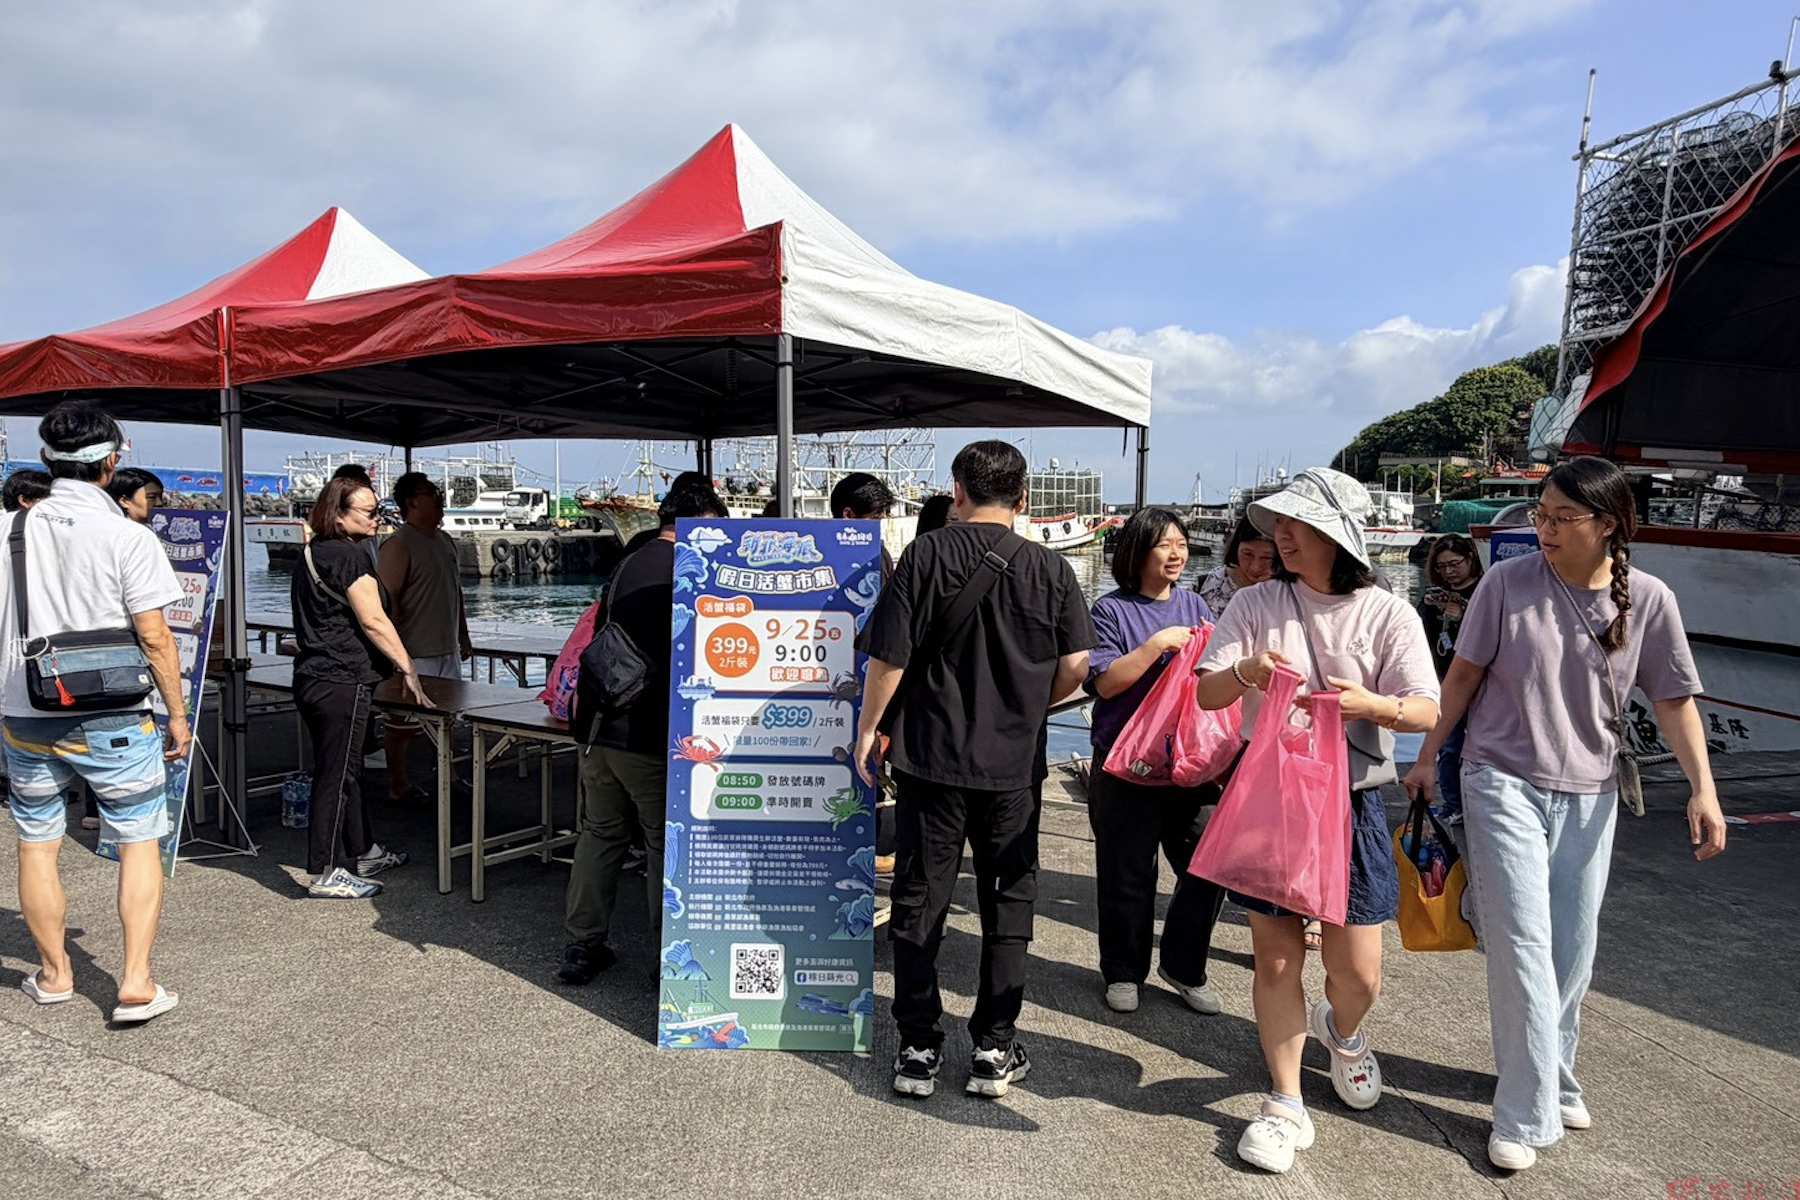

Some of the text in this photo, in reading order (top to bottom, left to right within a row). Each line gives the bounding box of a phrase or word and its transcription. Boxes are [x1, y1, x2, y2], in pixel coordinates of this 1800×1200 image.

[718, 567, 834, 591] 假日活蟹市集
[703, 602, 747, 613] 活蟹福袋
[775, 644, 827, 662] 9:00
[719, 657, 749, 669] 2斤裝
[701, 715, 760, 727] 活蟹福袋只要
[763, 704, 812, 728] $399
[1708, 712, 1750, 740] 基隆
[722, 775, 826, 787] 08:50 發放號碼牌
[721, 796, 813, 808] 09:00 準時開賣
